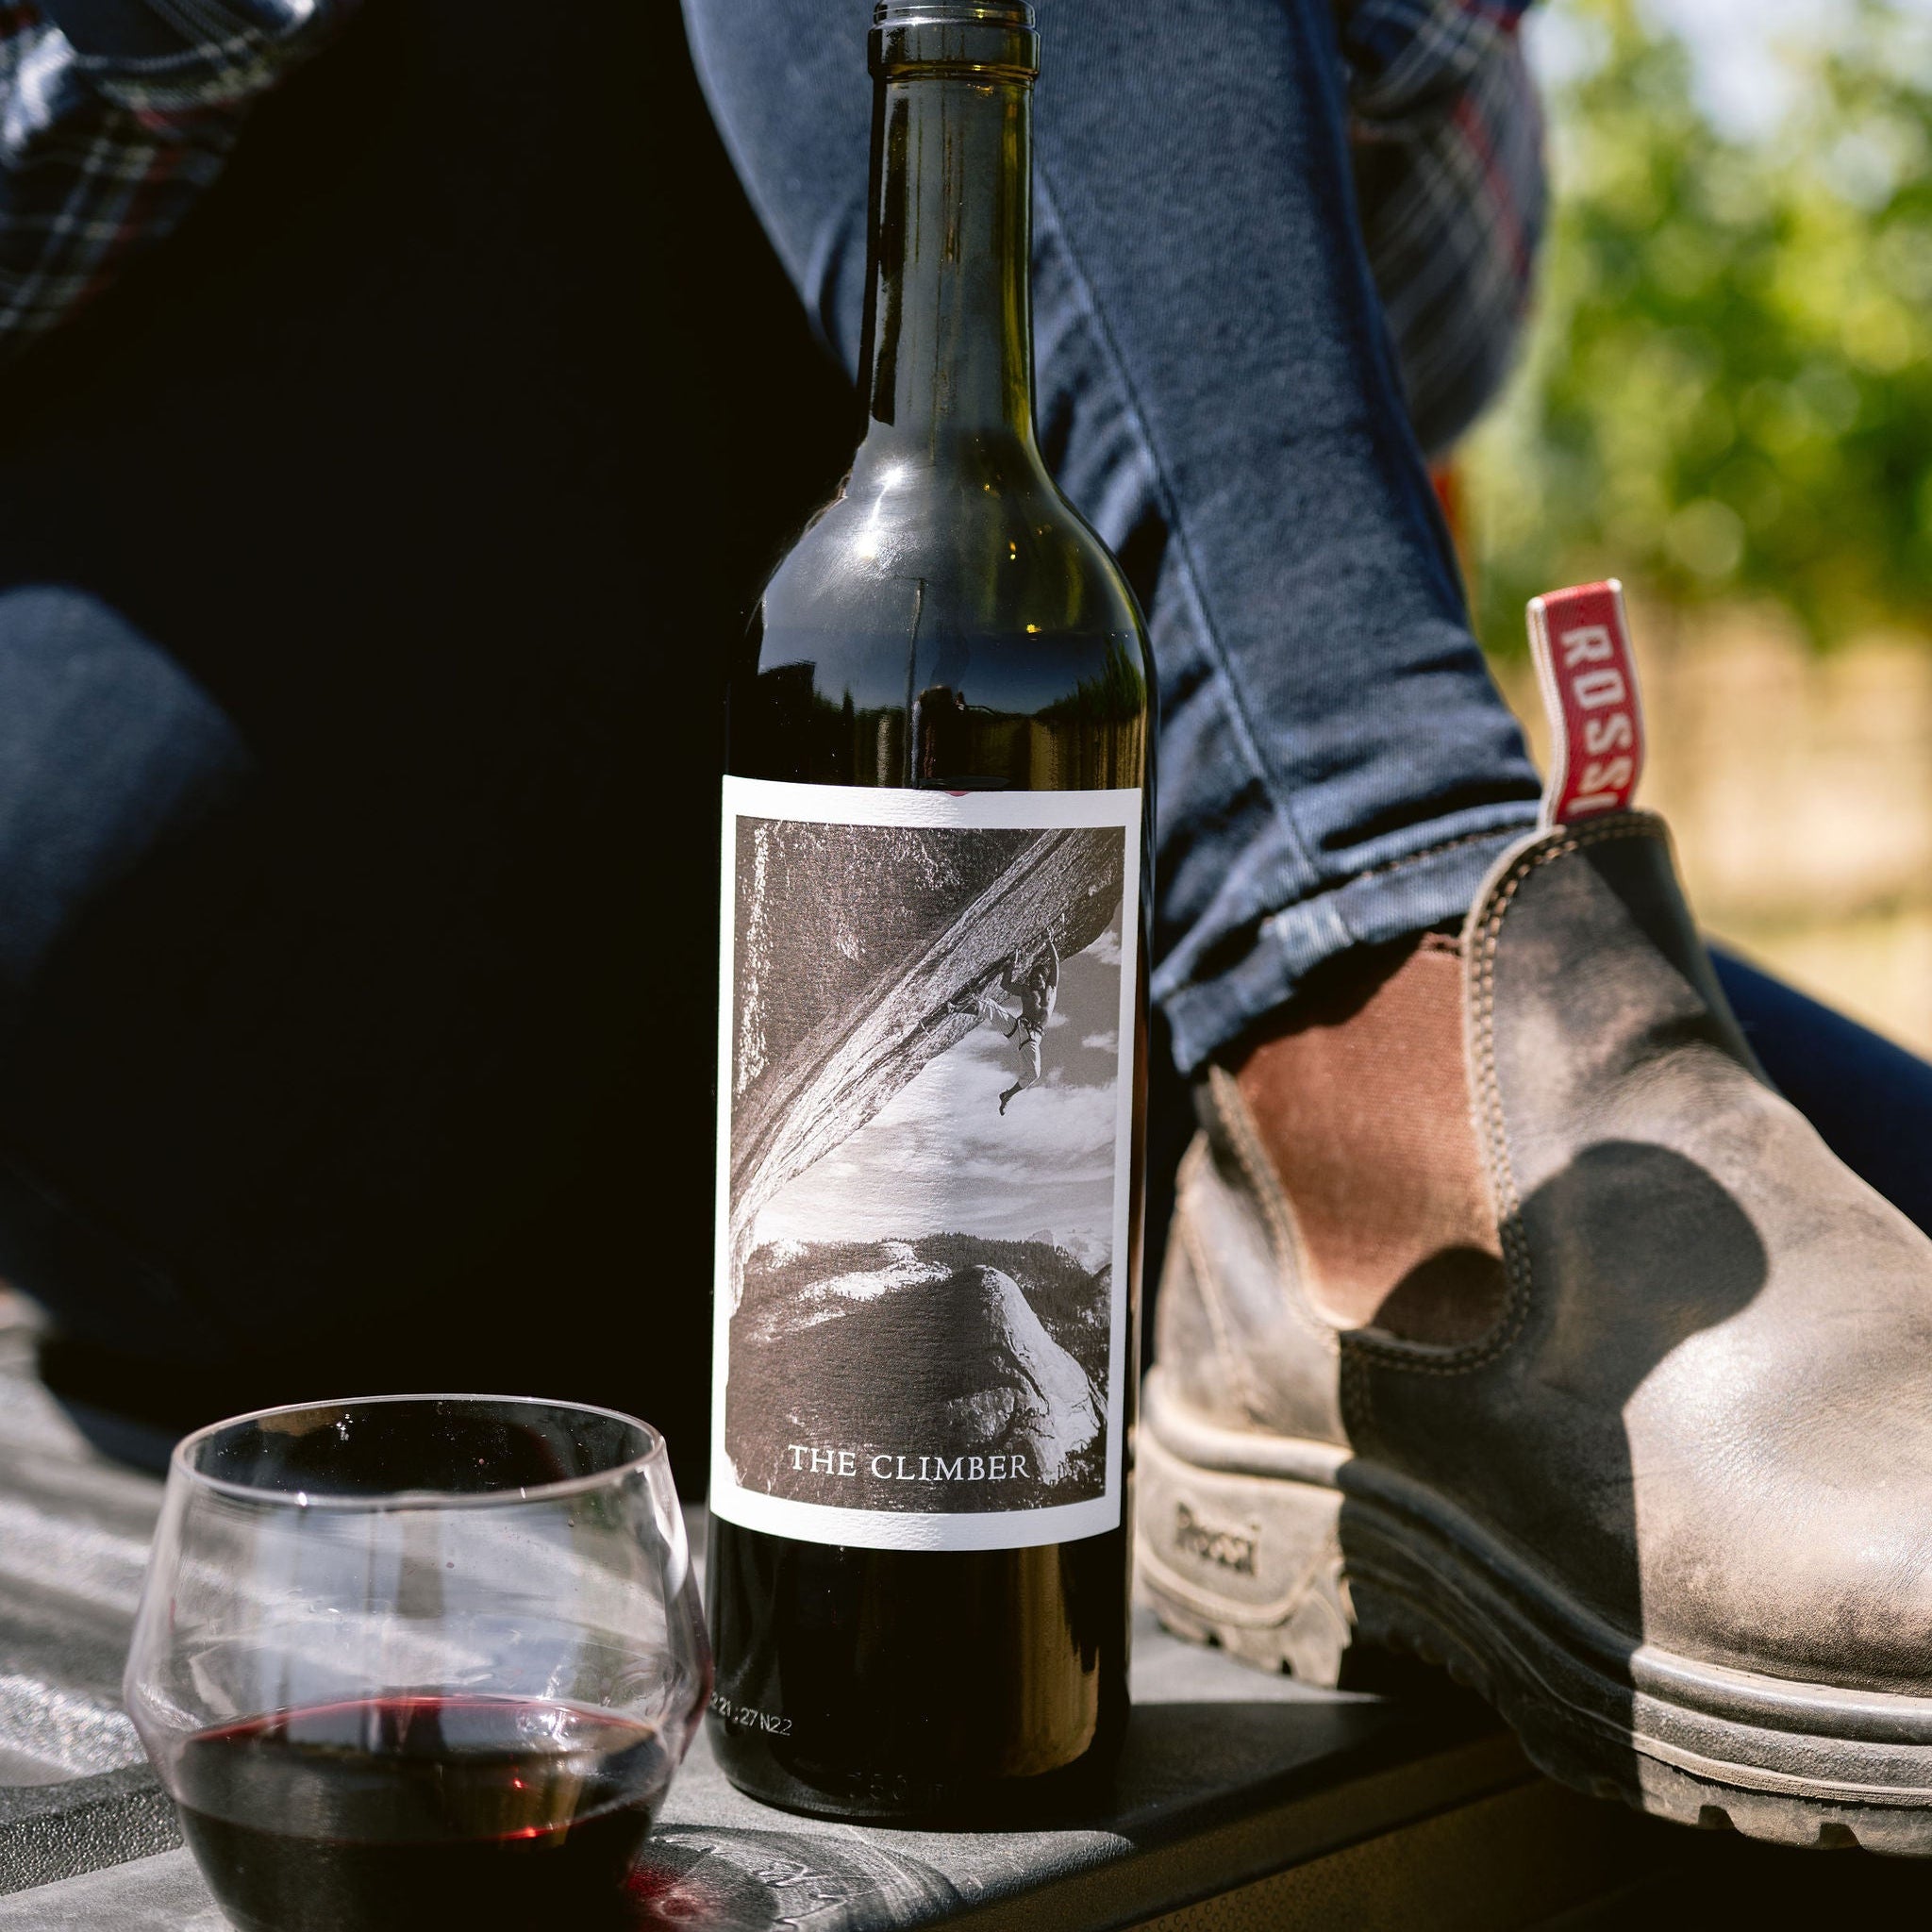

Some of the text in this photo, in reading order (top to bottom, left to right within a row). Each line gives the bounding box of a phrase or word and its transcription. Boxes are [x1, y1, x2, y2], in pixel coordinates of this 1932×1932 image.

[1560, 624, 1634, 816] ROSSI
[787, 1443, 1031, 1482] THE CLIMBER
